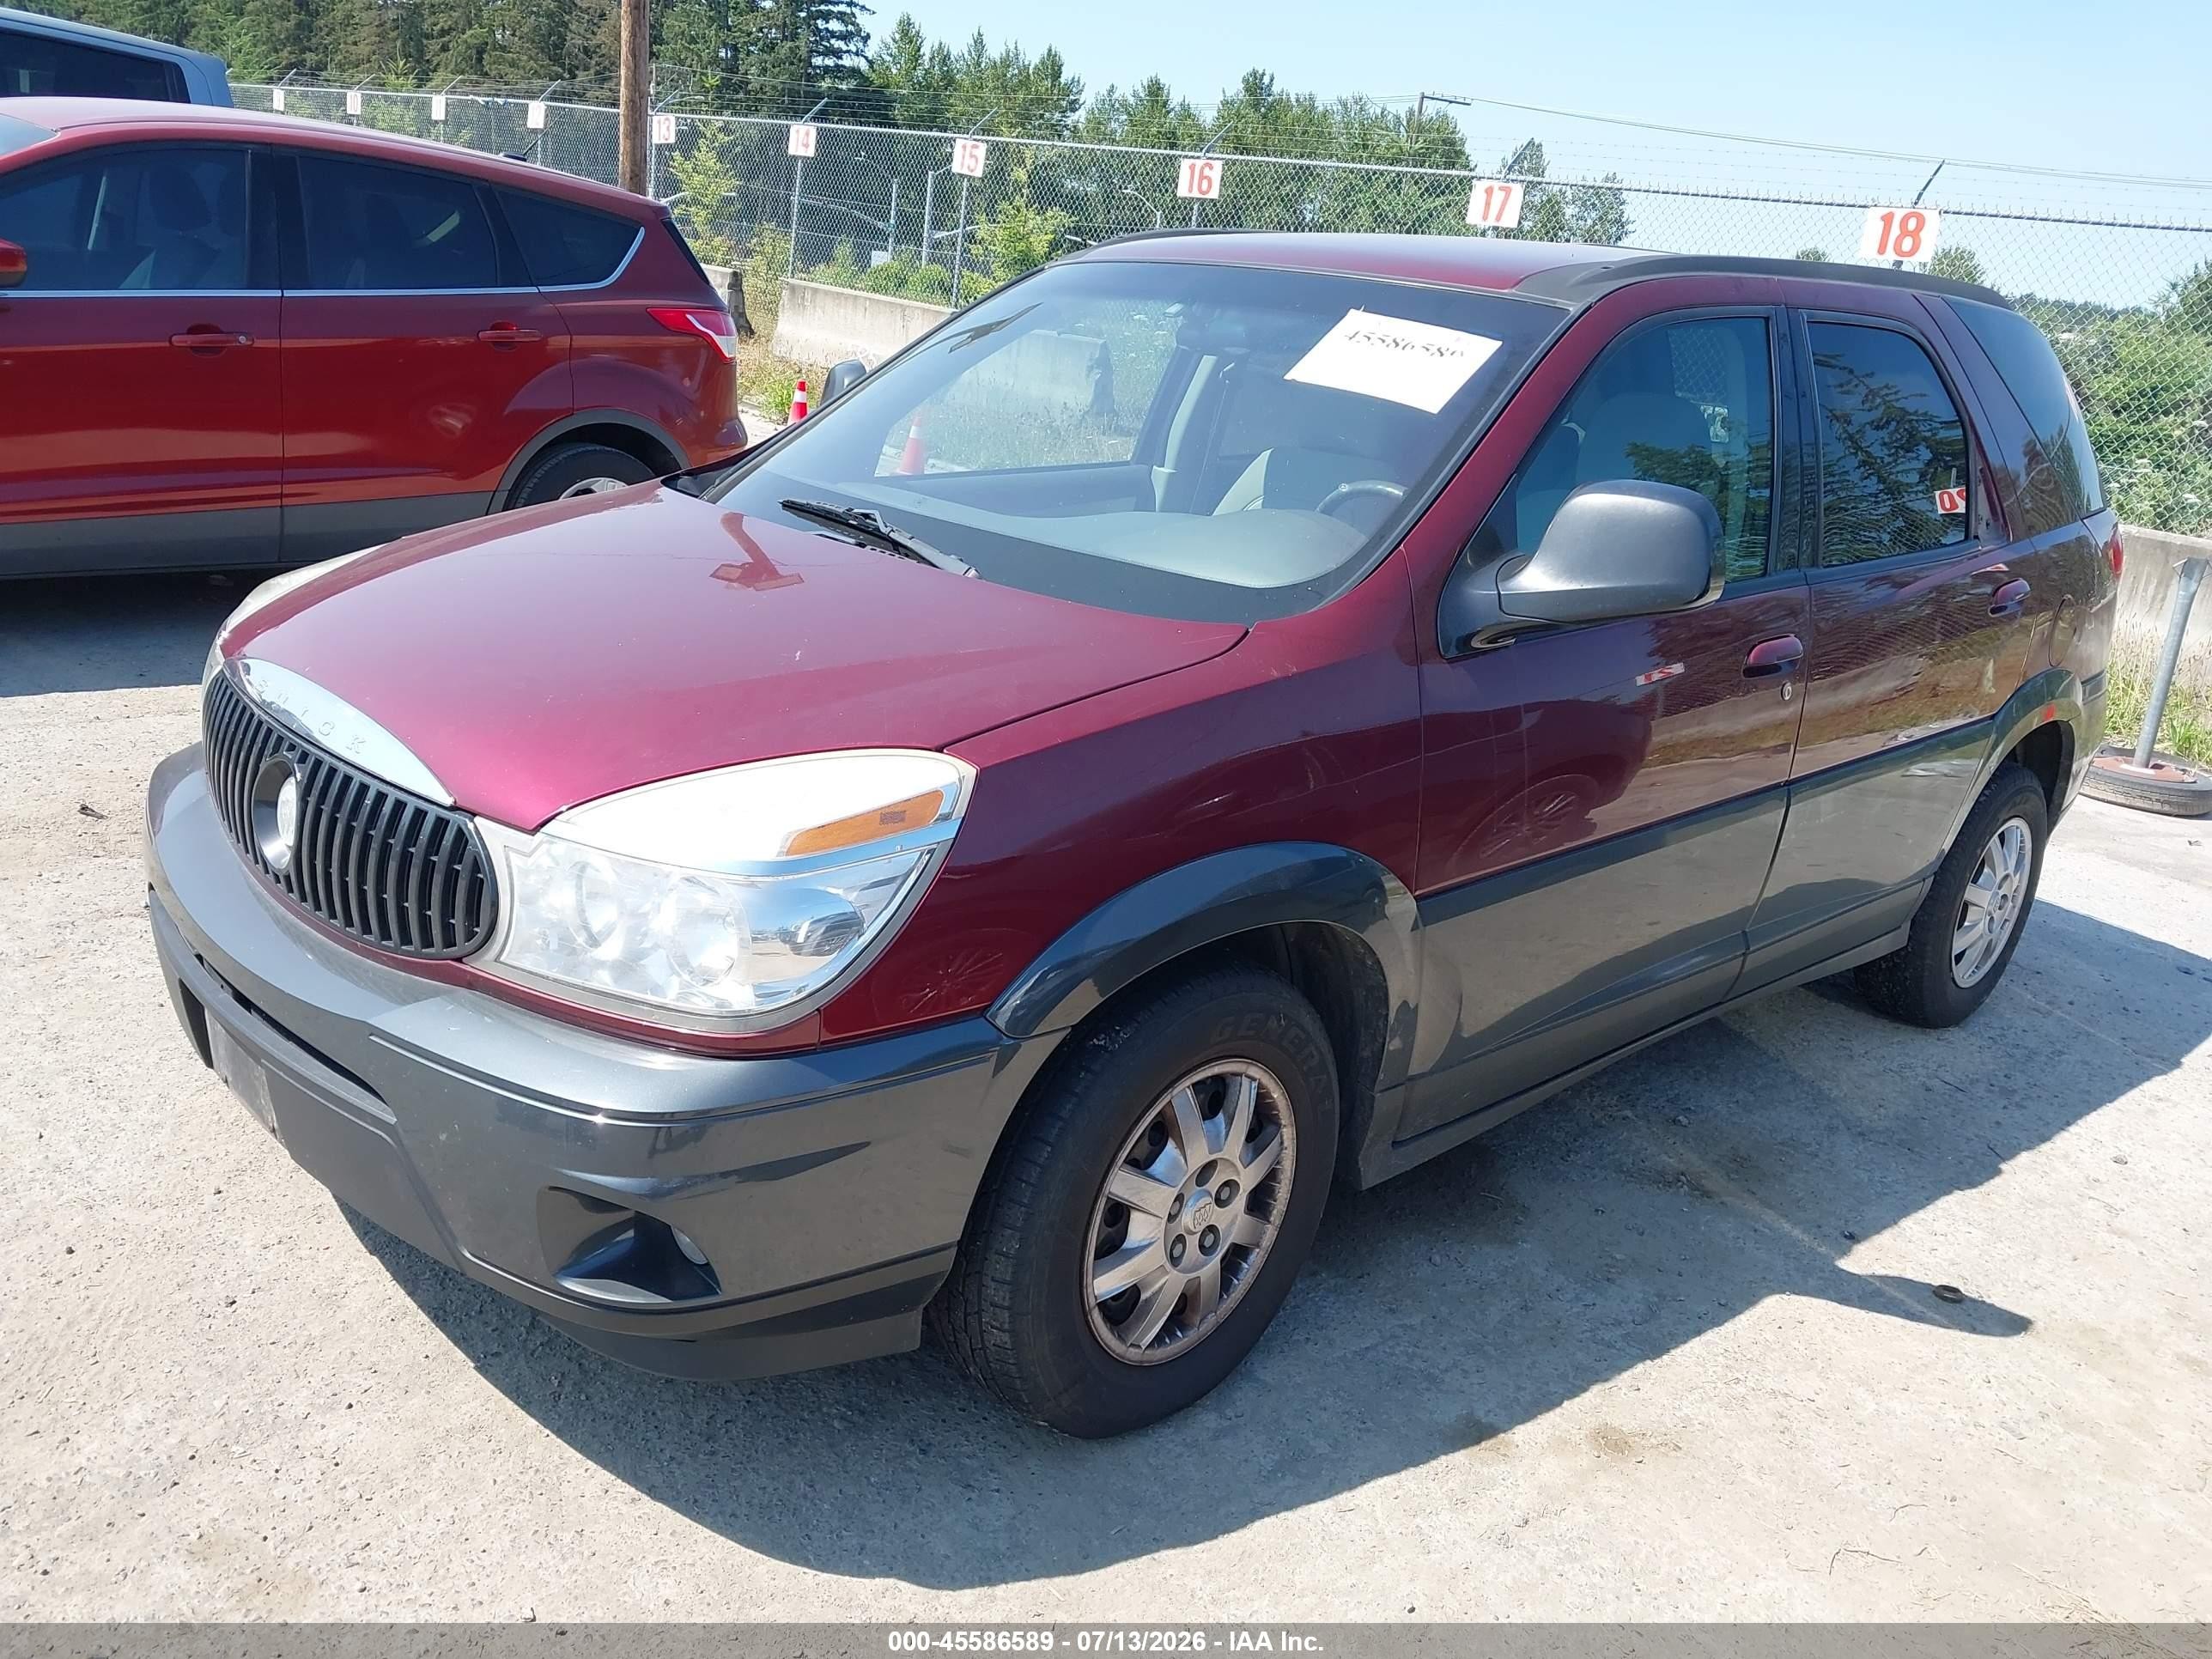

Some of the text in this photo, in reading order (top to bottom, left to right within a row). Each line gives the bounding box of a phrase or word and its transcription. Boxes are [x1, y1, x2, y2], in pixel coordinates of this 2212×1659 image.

[656, 117, 672, 142] 13
[793, 127, 811, 154] 14
[959, 143, 980, 173] 15
[1188, 161, 1214, 196] 16
[1481, 185, 1512, 223] 17
[1876, 210, 1926, 258] 18
[254, 678, 368, 755] BUICK
